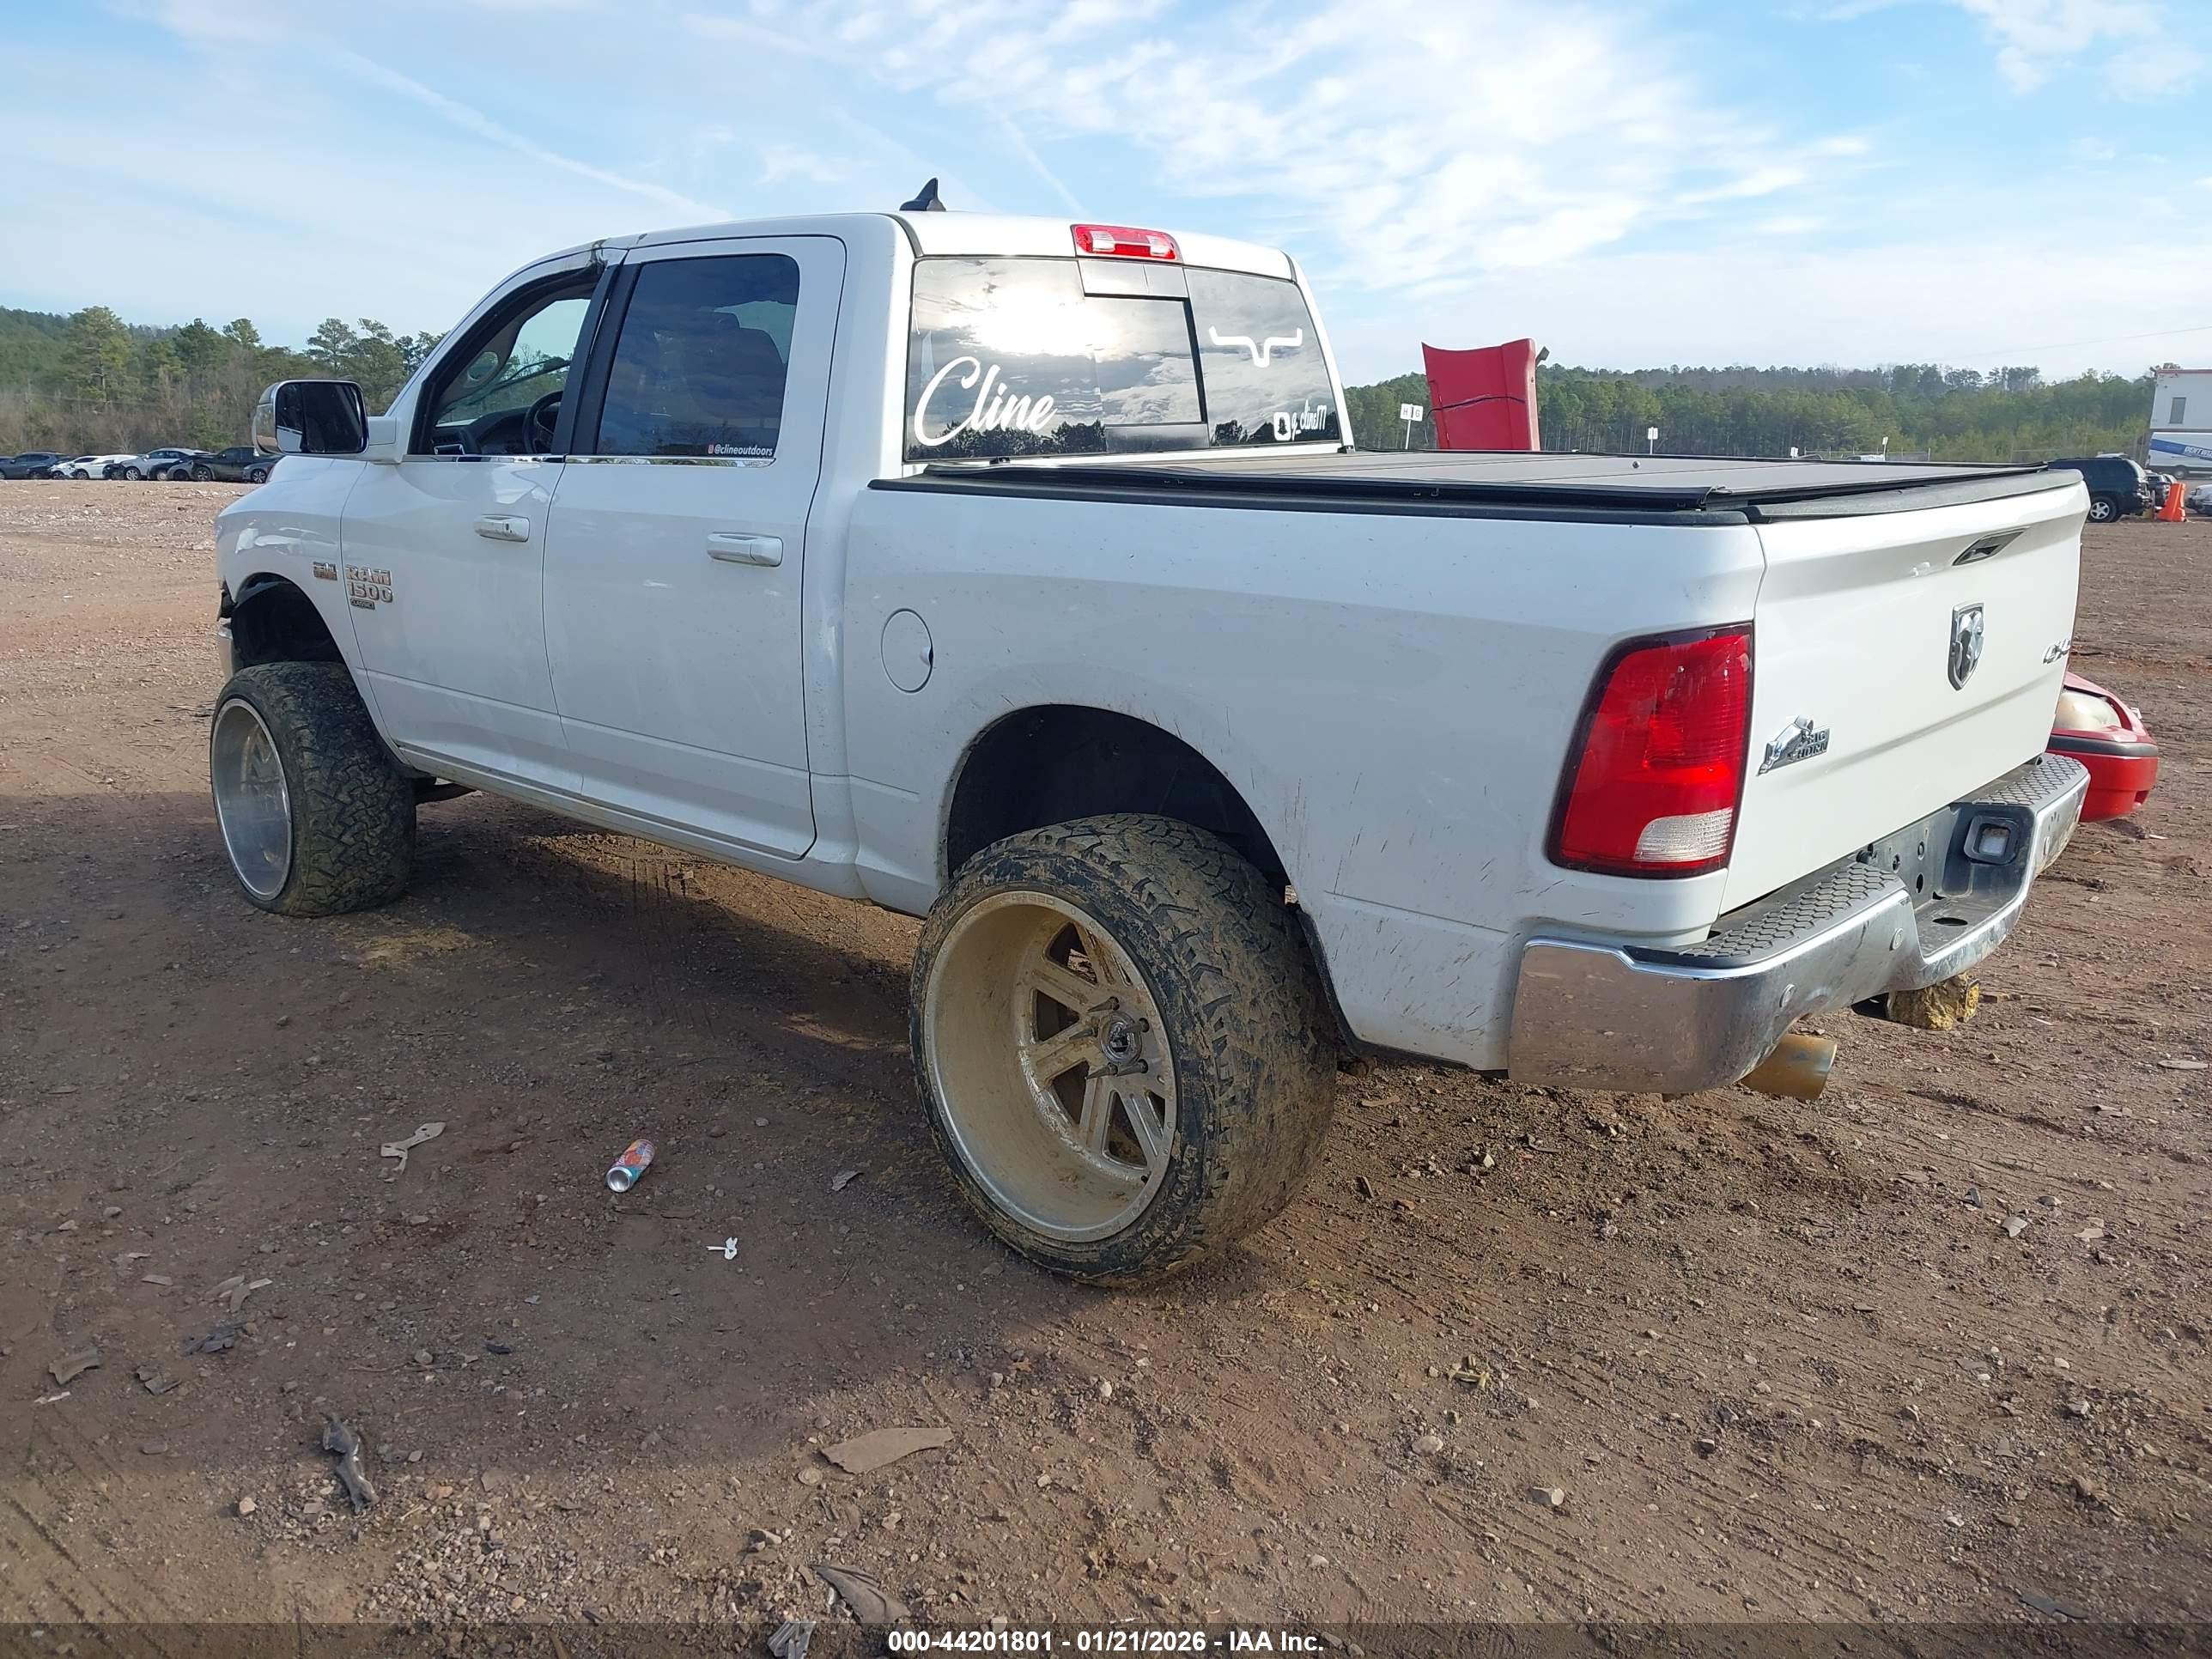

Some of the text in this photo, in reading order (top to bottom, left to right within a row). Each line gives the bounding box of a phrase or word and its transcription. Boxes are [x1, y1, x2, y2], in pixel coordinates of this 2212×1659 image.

[915, 356, 1058, 446] Cline
[714, 443, 774, 456] @clineoutdoors
[345, 565, 392, 586] RAM
[348, 582, 393, 603] 1500
[1796, 741, 1828, 759] HORN
